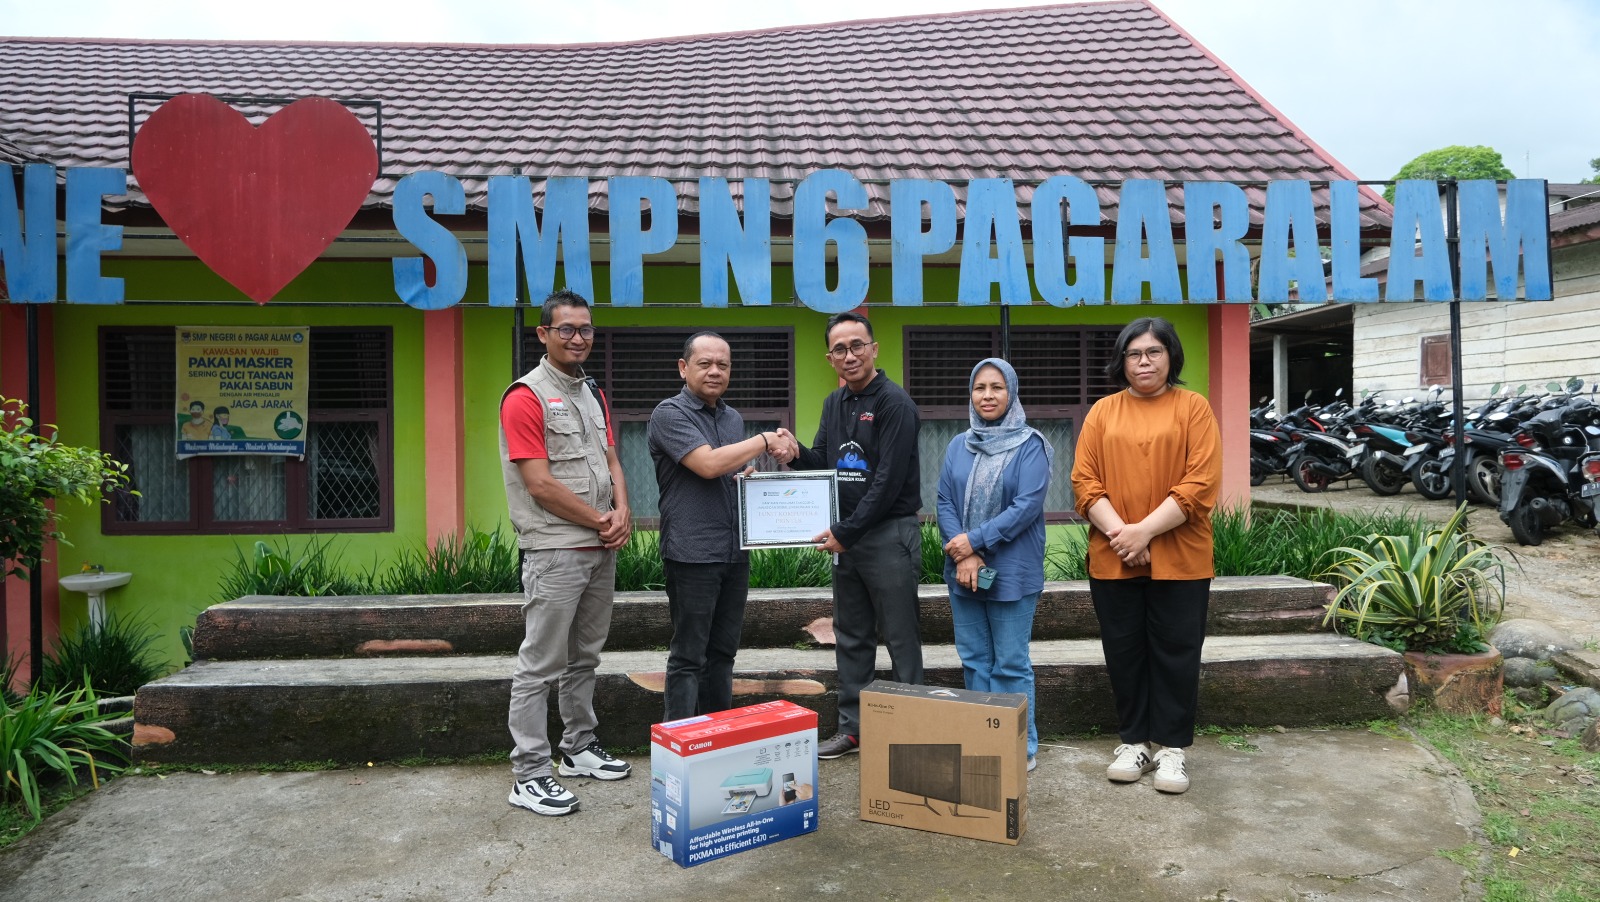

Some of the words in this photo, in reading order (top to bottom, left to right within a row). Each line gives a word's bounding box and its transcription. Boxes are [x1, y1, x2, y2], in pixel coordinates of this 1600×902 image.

[192, 333, 208, 342] SMP
[209, 333, 236, 342] NEGERI
[238, 333, 243, 342] 6
[245, 333, 269, 342] PAGAR
[270, 333, 291, 342] ALAM
[202, 347, 247, 356] KAWASAN
[250, 347, 279, 356] WAJIB
[188, 357, 232, 369] PAKAI
[234, 357, 293, 369] MASKER
[188, 370, 218, 378] SERING
[219, 371, 245, 380] CUCI
[247, 371, 294, 380] TANGAN
[219, 381, 252, 391] PAKAI
[254, 381, 293, 391] SABUN
[230, 400, 258, 409] JAGA
[260, 400, 293, 409] JARAK
[985, 717, 1001, 729] 19
[688, 740, 713, 751] Canon
[869, 798, 891, 811] LED
[868, 808, 904, 820] BACKLIGHT
[689, 830, 721, 845] Affordable
[721, 824, 746, 835] Wireless
[699, 838, 713, 849] high
[713, 834, 736, 844] volume
[736, 827, 760, 838] printing
[689, 848, 714, 863] PIXMA
[714, 845, 725, 856] Ink
[724, 838, 752, 852] Efficient
[752, 833, 767, 845] E470
